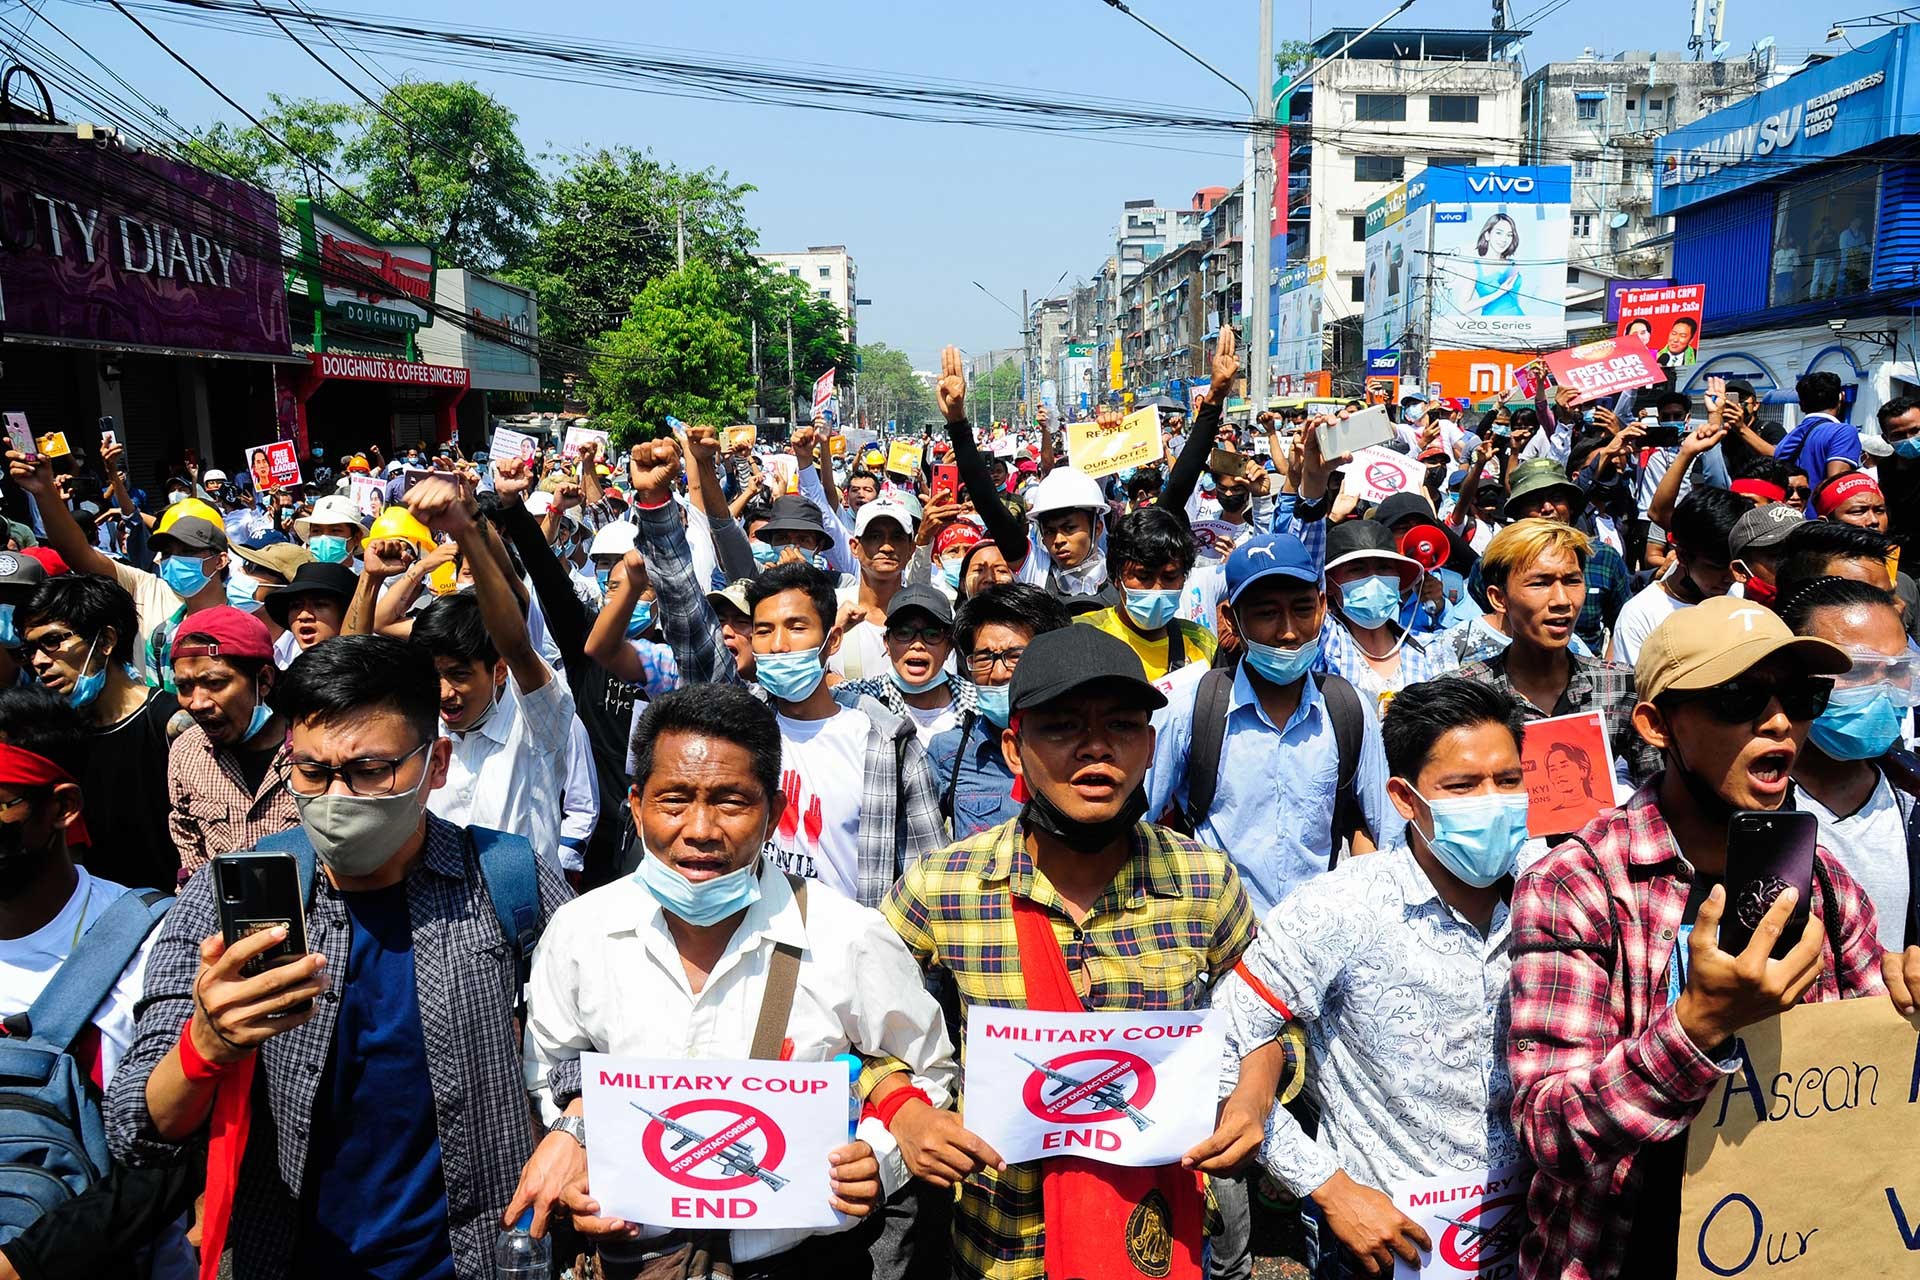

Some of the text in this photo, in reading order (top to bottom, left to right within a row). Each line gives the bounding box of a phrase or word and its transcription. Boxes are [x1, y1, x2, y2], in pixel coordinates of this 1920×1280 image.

[1804, 103, 1838, 126] PHOTO
[1758, 104, 1803, 155] SU
[1804, 119, 1833, 139] VIDEO
[1467, 171, 1535, 193] vivo
[1440, 213, 1462, 221] vivo
[118, 214, 232, 289] DIARY
[1627, 293, 1638, 304] We
[1639, 291, 1659, 302] stand
[1660, 289, 1676, 300] with
[348, 305, 416, 330] DOUGHNUTS
[1622, 307, 1632, 317] We
[1633, 305, 1653, 316] stand
[1654, 303, 1670, 315] with
[1456, 320, 1532, 330] V20 Series
[322, 355, 467, 385] DOUGHNUTS & COFFEE SINCE 1937
[1371, 358, 1396, 368] 360
[1566, 353, 1643, 382] FREE OUR
[1571, 364, 1649, 392] LEADERS
[1086, 418, 1141, 439] RESPECT
[271, 448, 289, 459] FREE
[273, 456, 289, 466] OUR
[1083, 447, 1149, 471] OUR VOTES
[271, 461, 298, 474] LEADER
[440, 582, 457, 590] OUR
[608, 678, 641, 697] super
[986, 1024, 1204, 1043] MILITARY COUP
[599, 1070, 829, 1095] MILITARY COUP
[1046, 1060, 1132, 1114] STOP DICTACTORSHIP
[670, 1115, 758, 1174] STOP DICTACTORSHIP
[1042, 1129, 1122, 1152] END
[1409, 1174, 1514, 1207] MILITARY
[671, 1197, 759, 1220] END
[1697, 1192, 1820, 1277] Our
[1459, 1246, 1478, 1263] STOP
